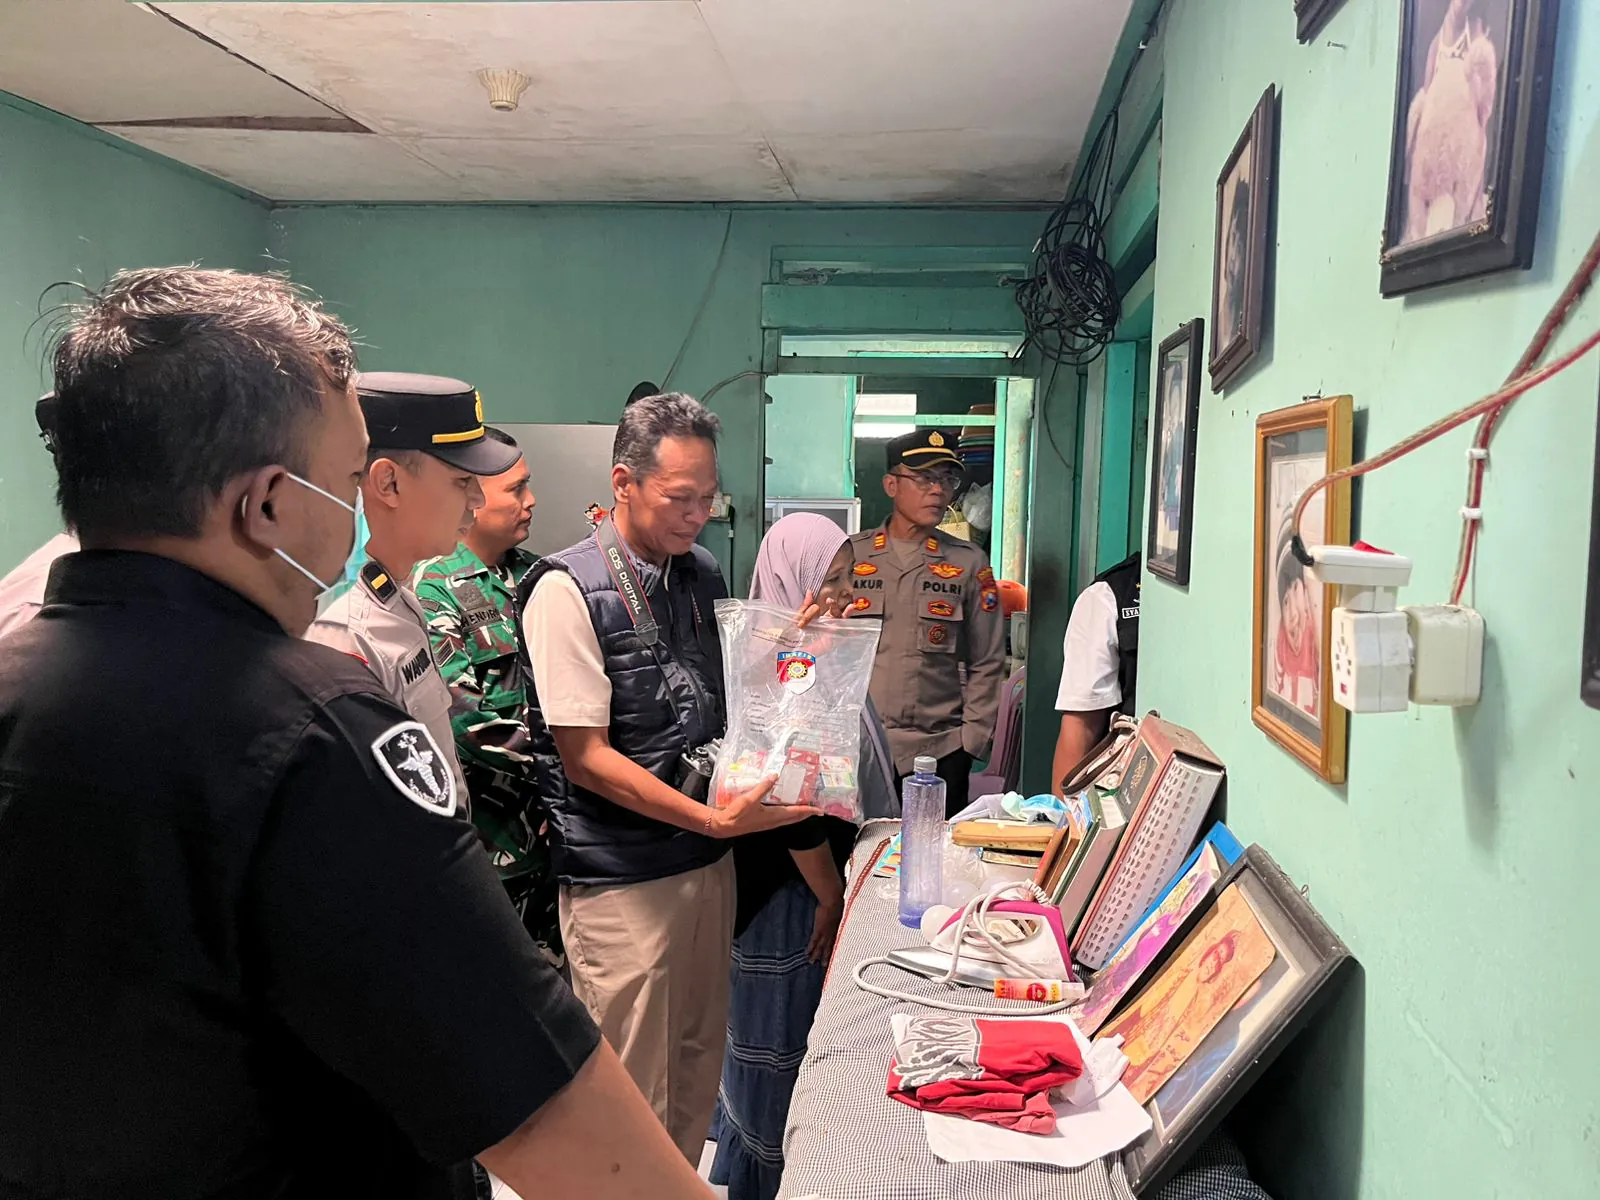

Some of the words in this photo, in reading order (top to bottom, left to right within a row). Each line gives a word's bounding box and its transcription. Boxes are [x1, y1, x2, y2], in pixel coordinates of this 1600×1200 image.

[608, 547, 624, 570] EOS
[619, 571, 642, 615] DIGITAL
[923, 581, 962, 595] POLRI
